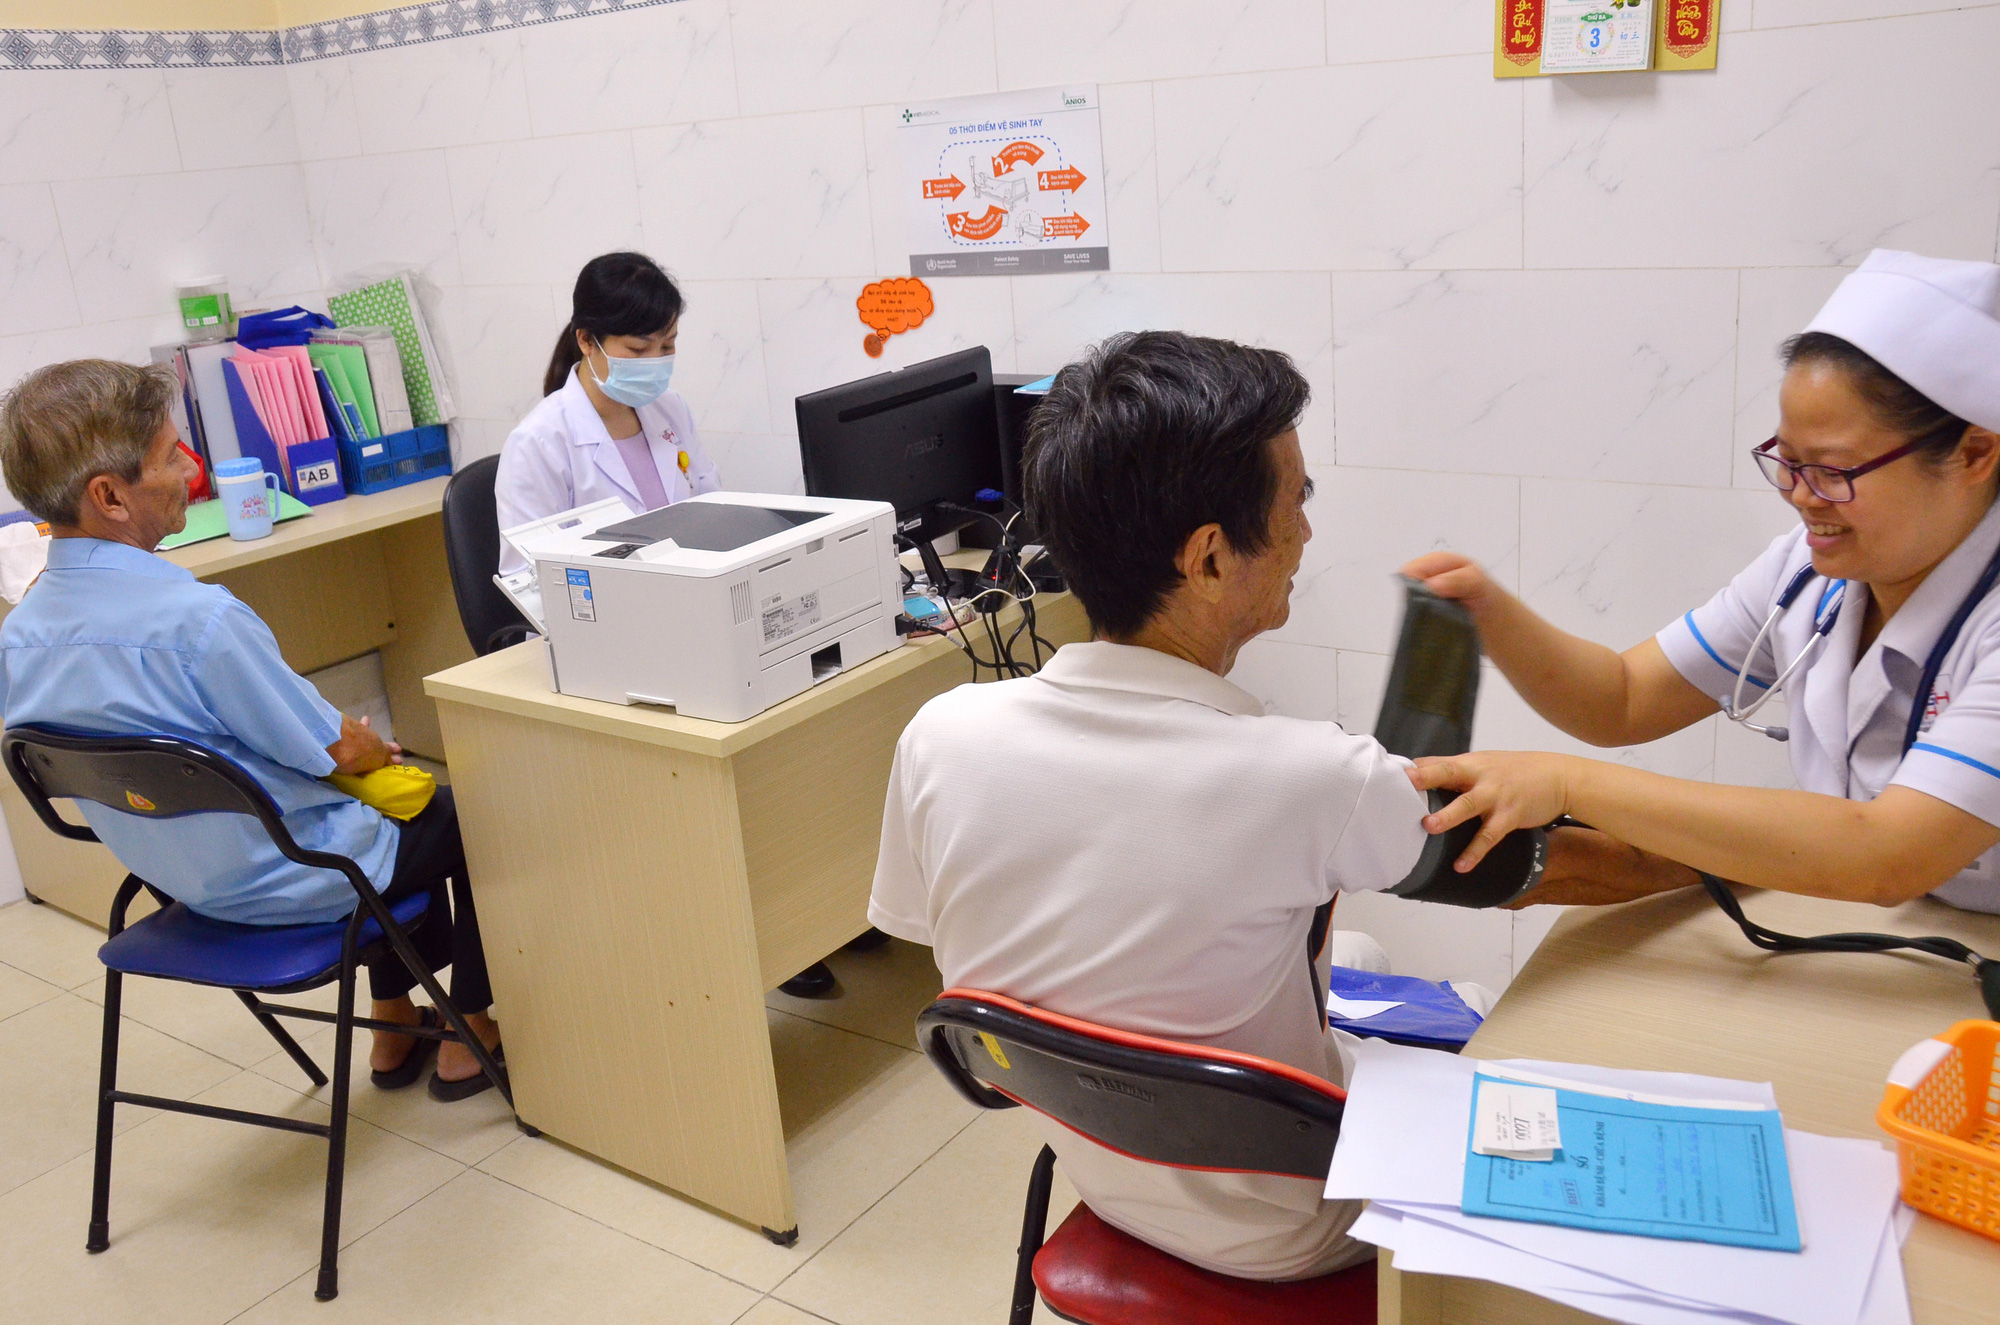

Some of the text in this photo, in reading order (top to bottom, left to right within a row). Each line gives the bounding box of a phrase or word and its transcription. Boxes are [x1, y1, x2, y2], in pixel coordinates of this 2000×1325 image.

[1590, 28, 1600, 48] 3
[1009, 120, 1027, 129] SINH
[1029, 118, 1043, 127] TAY
[994, 157, 1009, 173] 2
[1040, 173, 1049, 189] 4
[926, 182, 934, 197] 1
[953, 214, 966, 232] 3
[1044, 220, 1054, 235] 5
